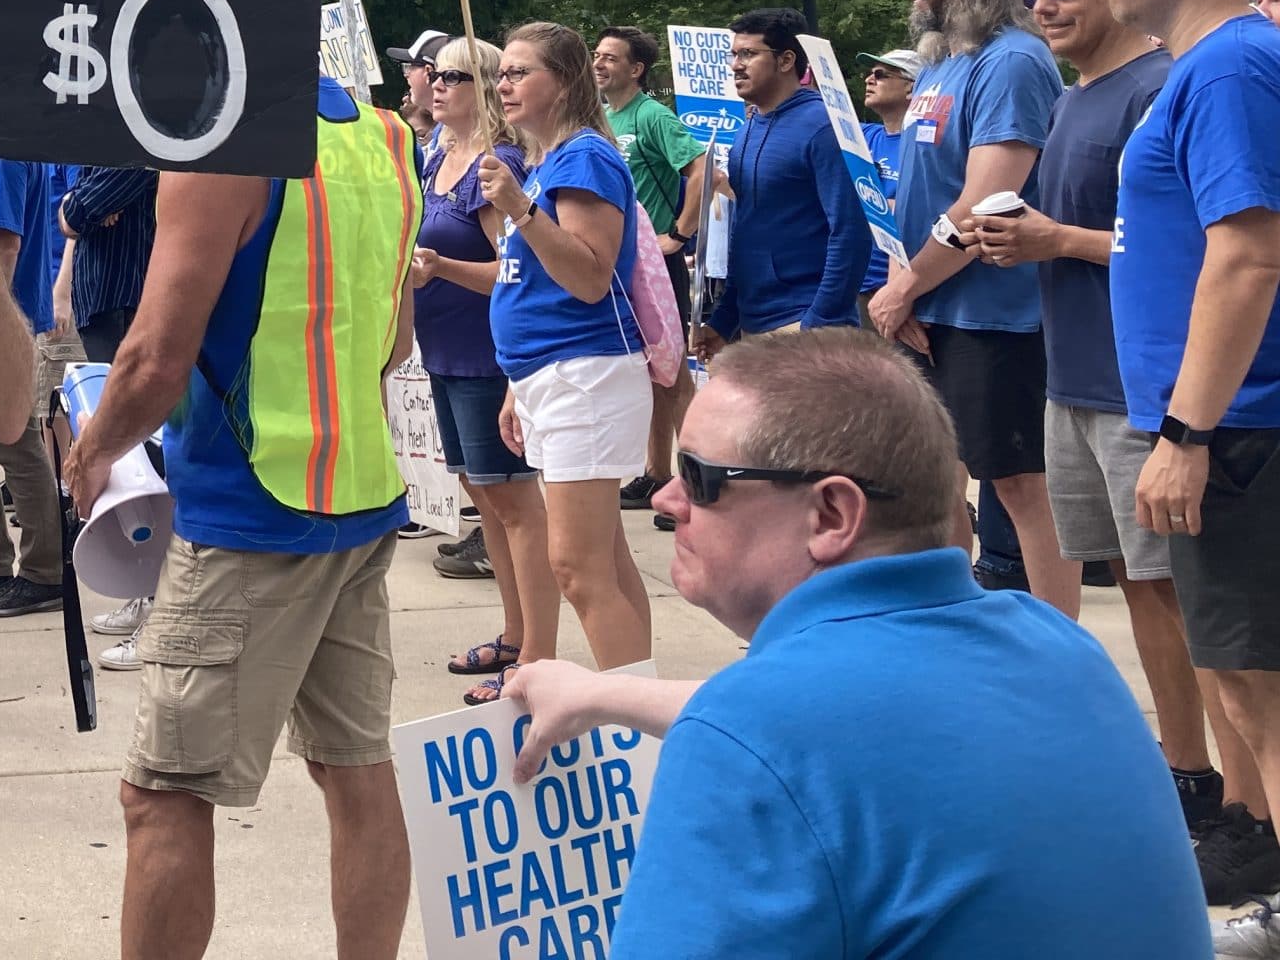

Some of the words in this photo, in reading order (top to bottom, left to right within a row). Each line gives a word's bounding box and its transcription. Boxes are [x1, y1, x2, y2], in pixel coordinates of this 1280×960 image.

[673, 31, 692, 46] NO
[696, 32, 731, 49] CUTS
[680, 47, 696, 62] TO
[701, 49, 728, 65] OUR
[678, 62, 733, 80] HEALTH-
[690, 79, 725, 96] CARE
[686, 114, 736, 130] OPEIU
[424, 727, 498, 803] NO
[449, 790, 518, 863] TO
[534, 758, 640, 839] OUR
